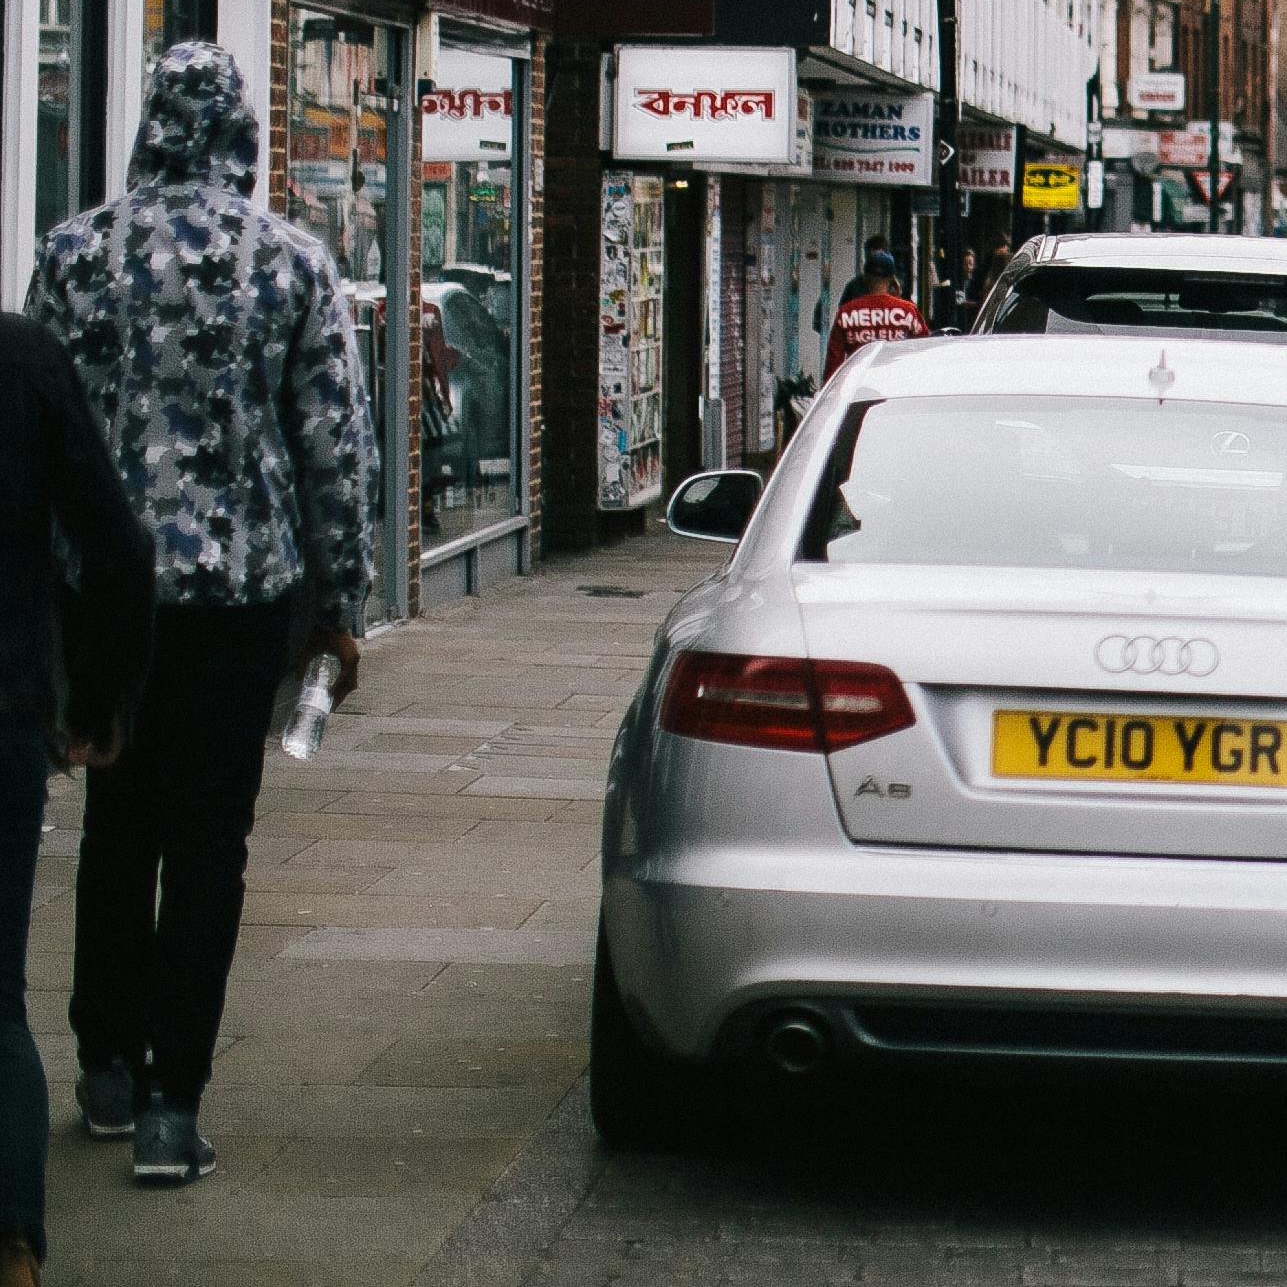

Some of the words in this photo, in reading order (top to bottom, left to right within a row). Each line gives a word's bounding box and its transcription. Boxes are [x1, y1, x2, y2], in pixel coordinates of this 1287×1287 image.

[633, 89, 775, 122] বনফুল
[813, 121, 921, 142] ROTHERS
[1029, 716, 1153, 771] YC10
[1175, 720, 1281, 775] YGR
